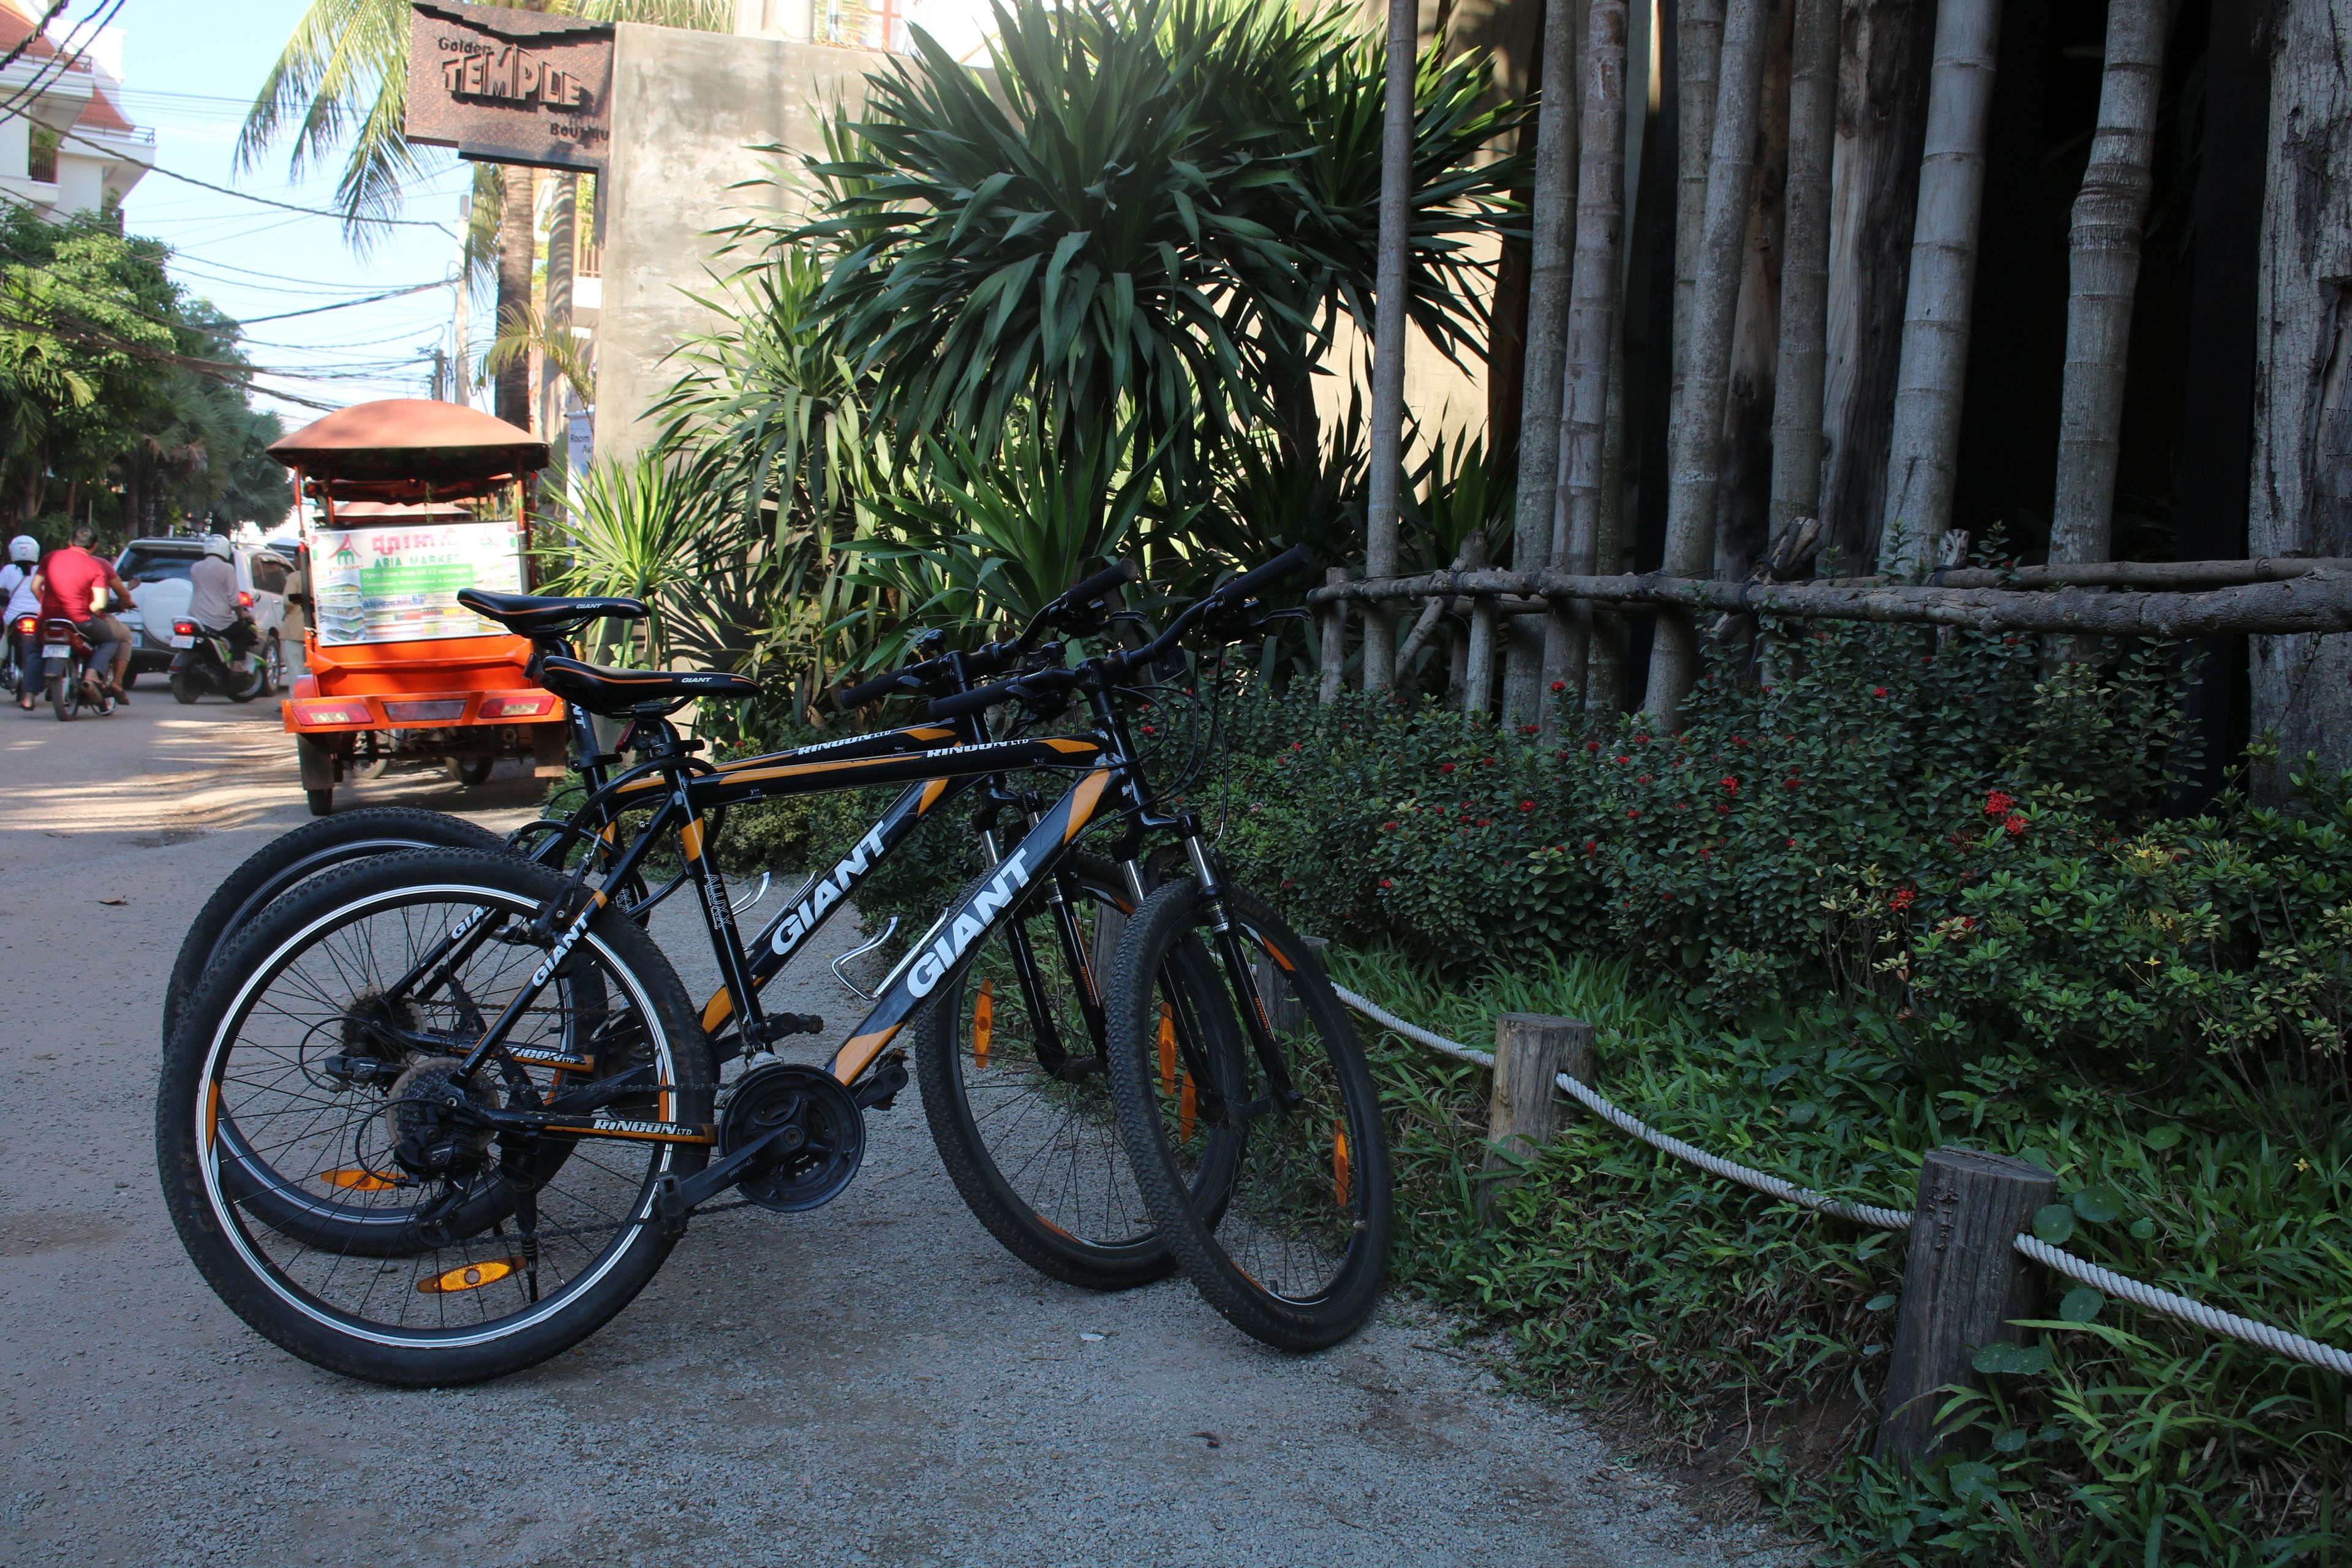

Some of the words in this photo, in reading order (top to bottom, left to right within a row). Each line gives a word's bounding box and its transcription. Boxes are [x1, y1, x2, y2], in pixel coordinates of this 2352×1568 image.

[439, 37, 491, 55] Golden
[442, 43, 581, 106] TEMPLE
[570, 434, 590, 443] Room
[374, 556, 402, 568] ASIA
[410, 554, 460, 565] MARKET
[704, 874, 733, 929] ALUXX
[771, 821, 887, 956] GIANT
[451, 906, 484, 940] GIA
[907, 848, 1030, 998] GIANT
[532, 911, 589, 987] GIANT
[594, 1118, 677, 1134] RINCON
[677, 1127, 692, 1136] LTD
